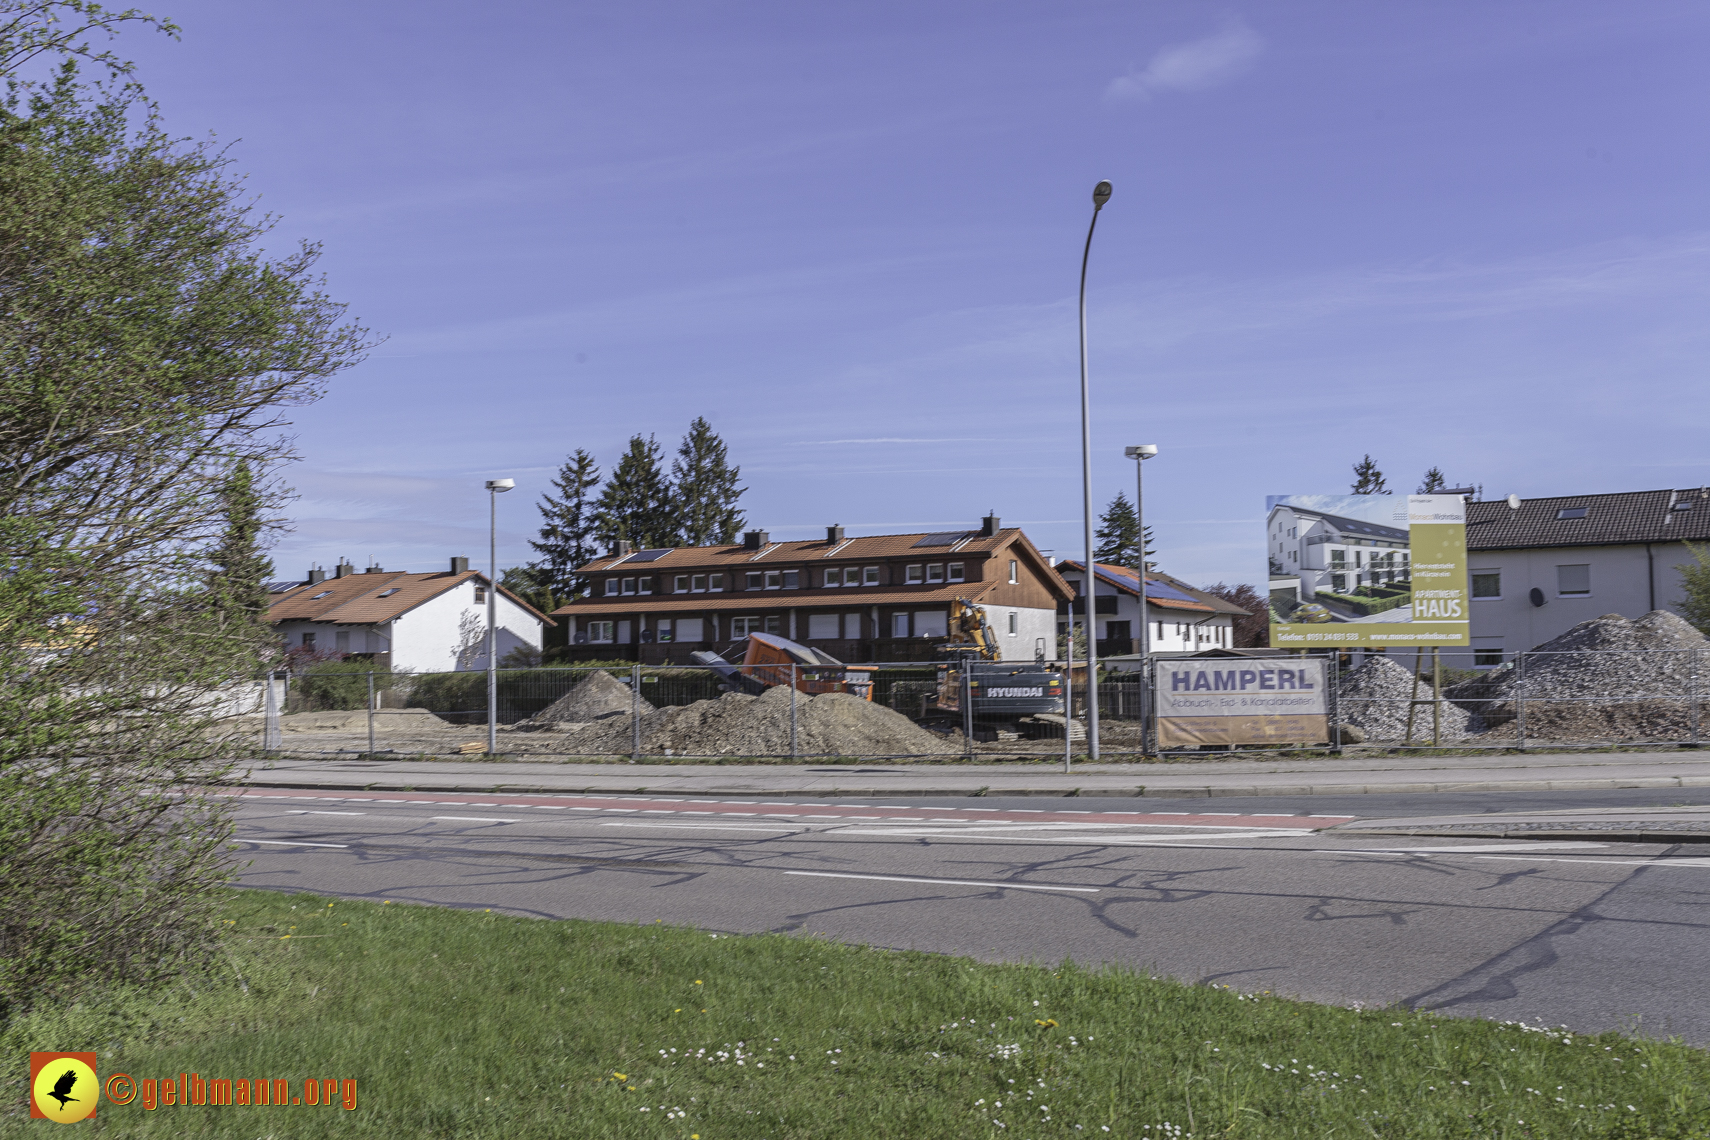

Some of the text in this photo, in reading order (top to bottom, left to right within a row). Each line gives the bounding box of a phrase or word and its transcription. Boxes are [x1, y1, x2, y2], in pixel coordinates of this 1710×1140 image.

[1414, 589, 1463, 599] APARTMENT-
[1414, 599, 1462, 618] HAUS
[1277, 632, 1305, 641] Telefon:
[1171, 669, 1314, 692] HAMPERL
[987, 687, 1043, 698] HYUNDAI
[1240, 698, 1248, 707] &
[1250, 697, 1316, 707] Kanalarbeiten
